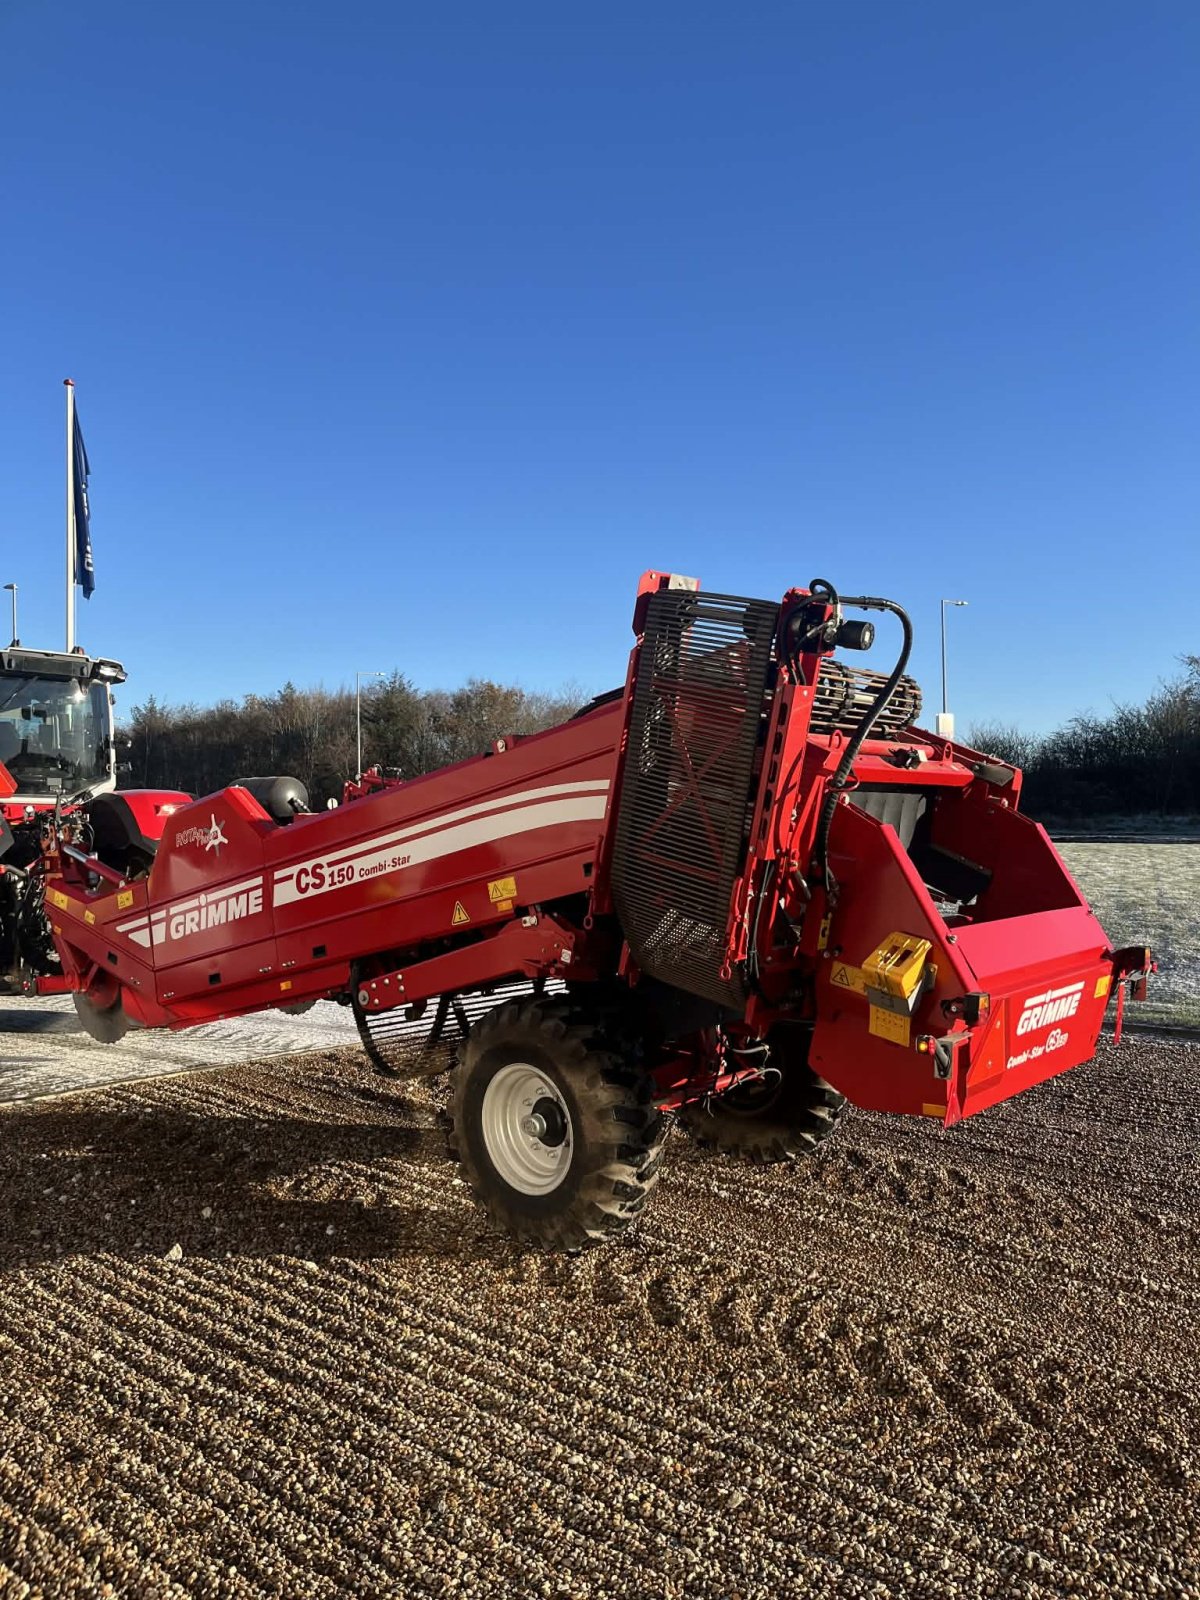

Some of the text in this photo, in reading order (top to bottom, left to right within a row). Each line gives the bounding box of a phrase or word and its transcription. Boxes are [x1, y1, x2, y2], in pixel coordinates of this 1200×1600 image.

[328, 864, 355, 888] 150
[358, 855, 411, 878] Combi-Star
[169, 887, 263, 940] GRIMME
[1016, 991, 1082, 1036] GRIMME
